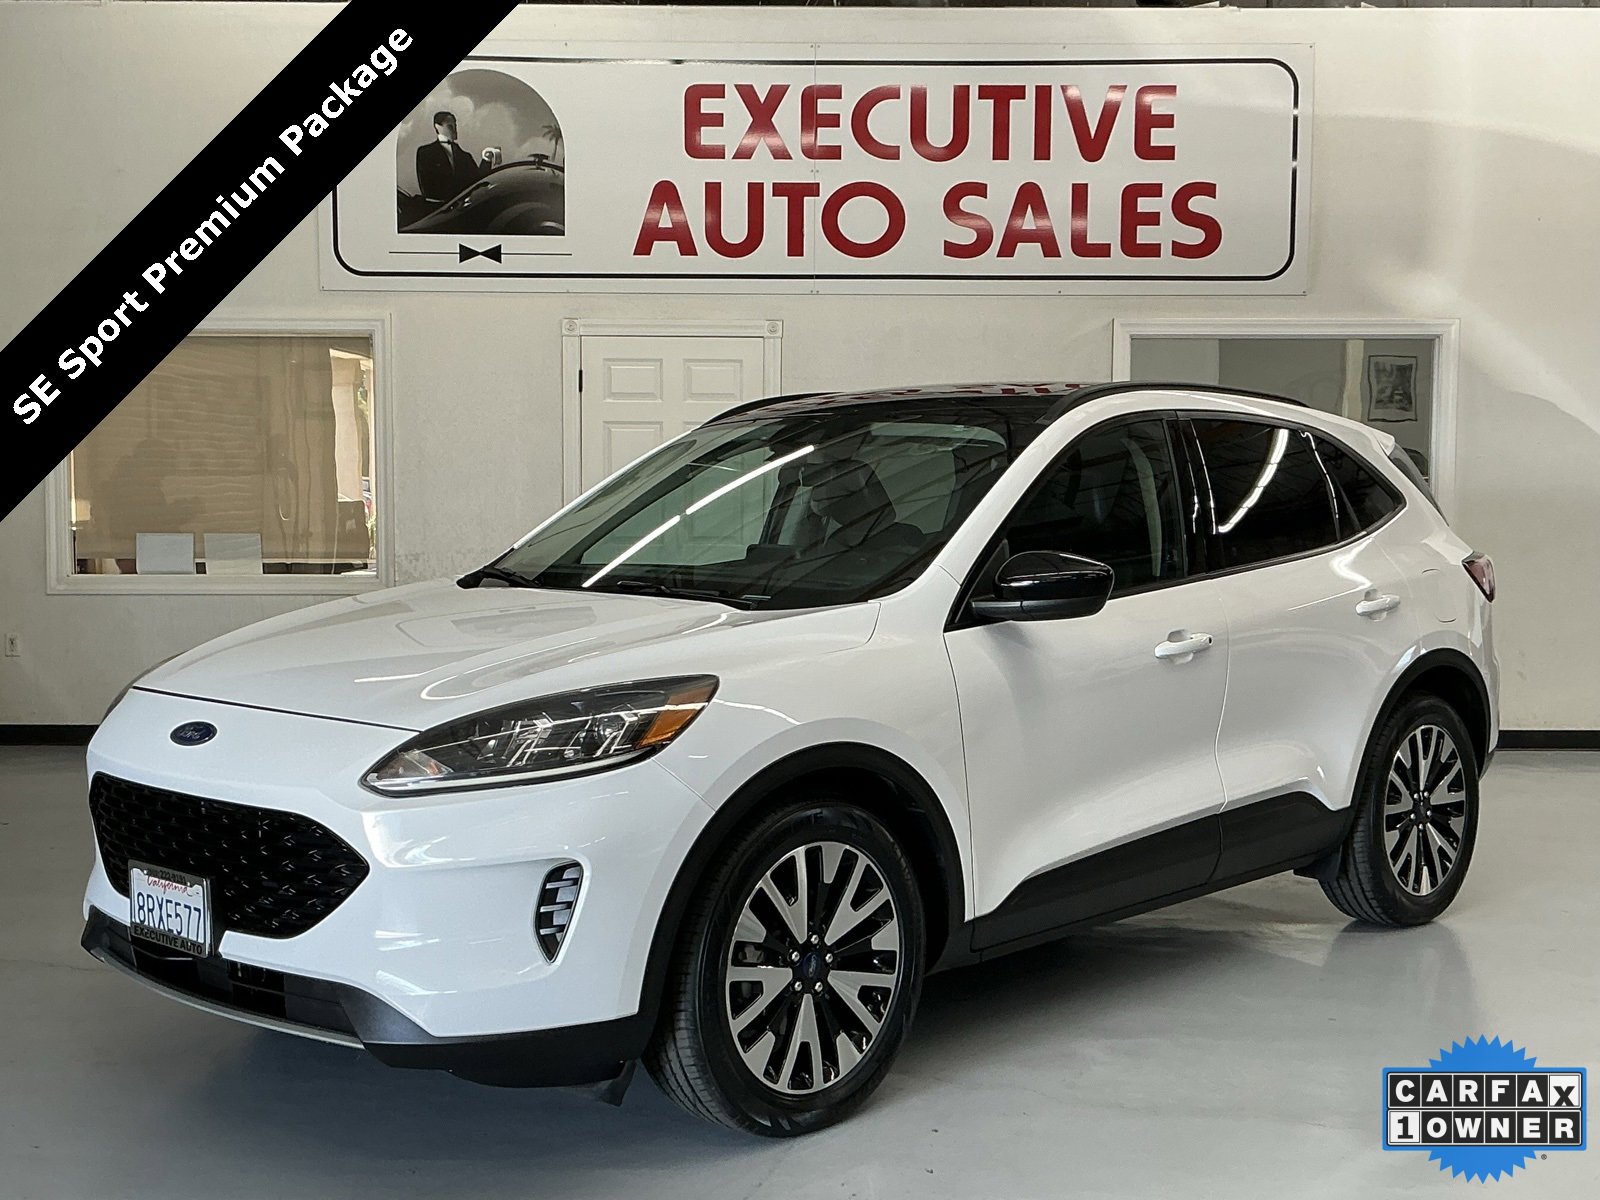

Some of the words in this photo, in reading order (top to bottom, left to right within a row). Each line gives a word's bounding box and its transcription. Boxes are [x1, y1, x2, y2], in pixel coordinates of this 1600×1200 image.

[683, 83, 1178, 163] EXECUTIVE
[633, 180, 906, 259] AUTO
[943, 181, 1222, 259] SALES
[134, 925, 178, 947] EXECUTIVE
[180, 940, 203, 955] AUTO
[137, 891, 201, 942] 8RXE577
